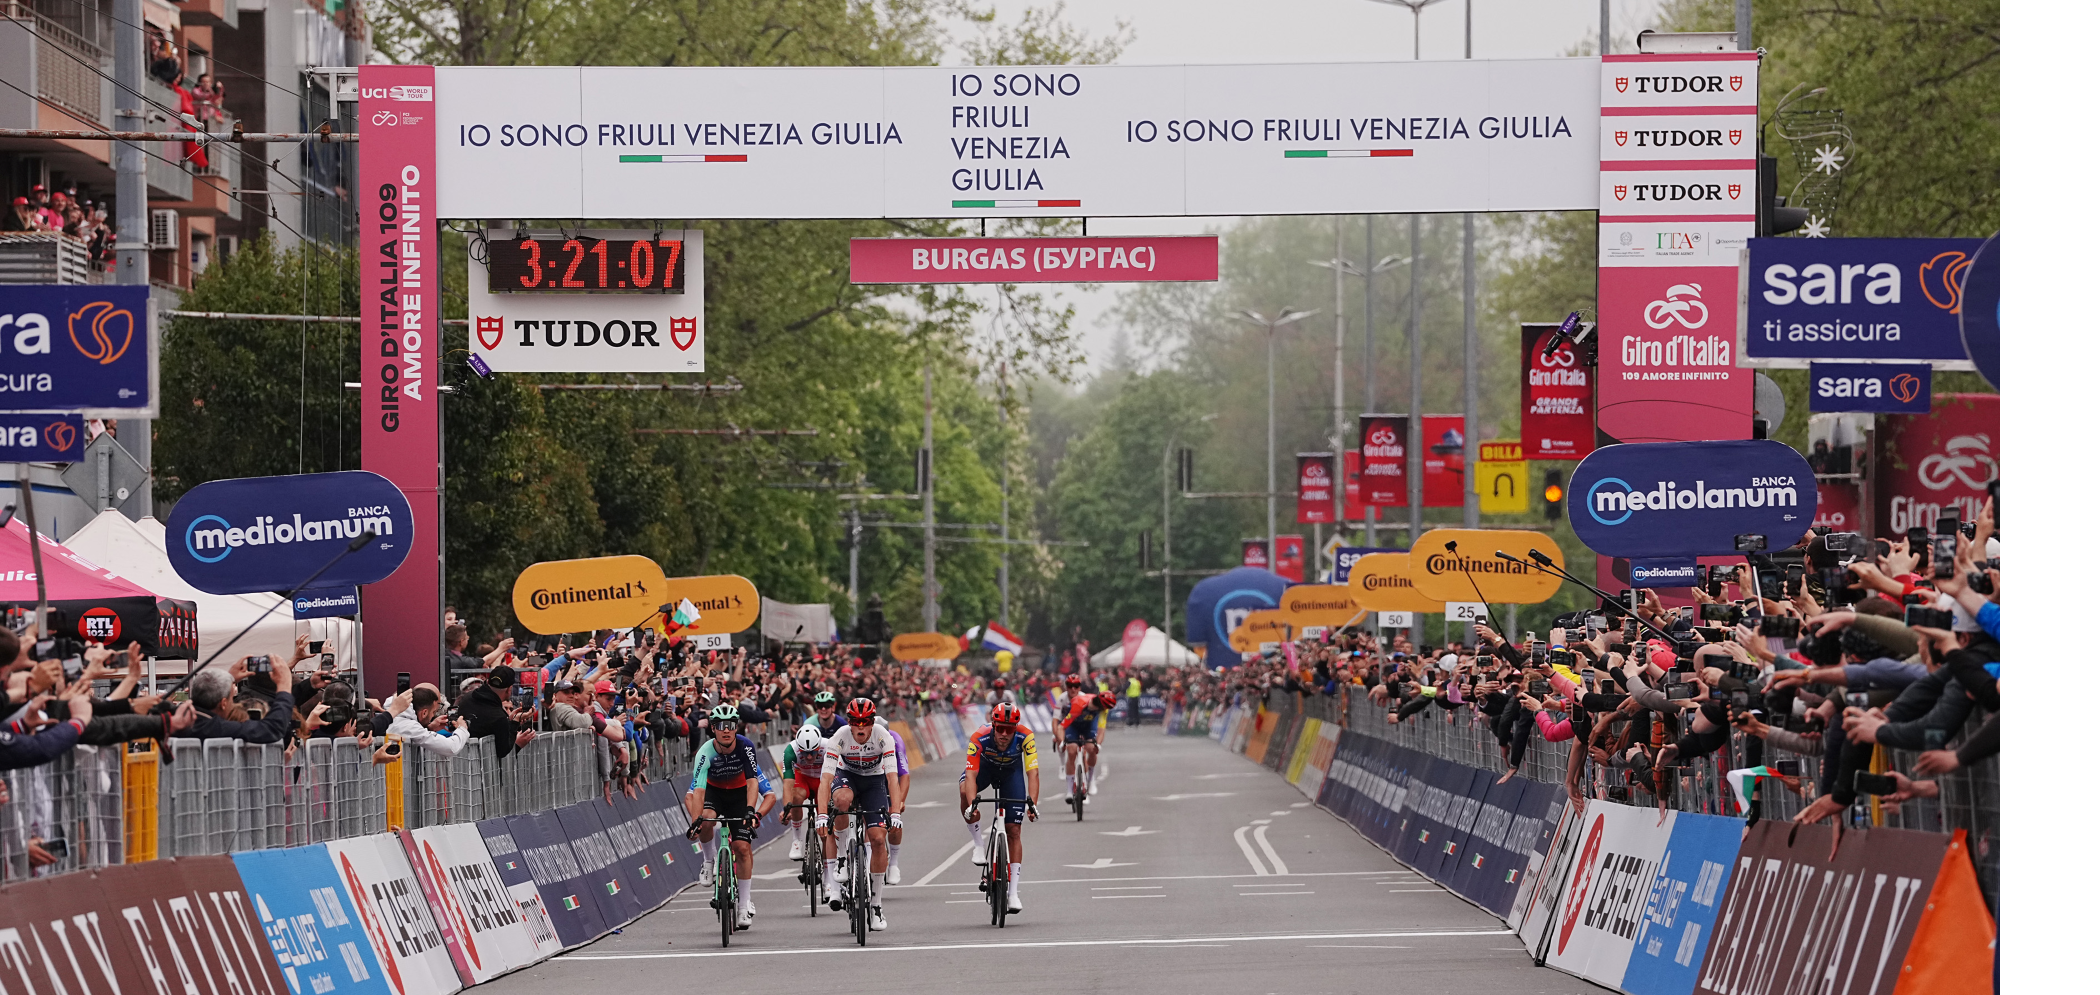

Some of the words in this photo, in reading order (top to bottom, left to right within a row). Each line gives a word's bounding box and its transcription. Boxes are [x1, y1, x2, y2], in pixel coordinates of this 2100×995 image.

[361, 88, 387, 99] UCI
[952, 74, 983, 97] IO
[993, 73, 1081, 97] SONO
[1635, 76, 1724, 93] TUDOR
[952, 105, 1029, 128] FRIULI
[460, 124, 491, 147] IO
[500, 123, 588, 147] SONO
[598, 123, 675, 146] FRIULI
[683, 122, 804, 146] VENEZIA
[811, 121, 903, 146] GIULIA
[1127, 120, 1158, 143] IO
[1166, 119, 1254, 143] SONO
[1264, 118, 1341, 142] FRIULI
[1349, 117, 1470, 141] VENEZIA
[1478, 115, 1573, 140] GIULIA
[1634, 129, 1723, 147] TUDOR
[951, 136, 1071, 160] VENEZIA
[951, 167, 1044, 192] GIULIA
[1633, 183, 1722, 202] TUDOR
[379, 183, 397, 235] 109
[401, 165, 421, 287] INFINITO
[1656, 233, 1694, 250] ITA
[520, 239, 682, 288] 3:21:07
[912, 247, 1027, 270] BURGAS
[1033, 246, 1156, 273] (БУРГАС)
[1762, 262, 1901, 306] sara
[380, 239, 398, 357] D'ITALIA
[514, 319, 660, 348] TUDOR
[1762, 319, 1782, 342] ti
[1788, 318, 1901, 342] assicura
[403, 294, 422, 401] AMORE
[1621, 335, 1663, 367] Giro
[1665, 334, 1730, 367] d'Italia
[1529, 368, 1550, 386] Giro
[1621, 371, 1640, 381] 109
[1641, 371, 1680, 381] AMORE
[1681, 371, 1730, 381] INFINITO
[1817, 377, 1882, 398] sara
[380, 364, 399, 433] GIRO
[1536, 397, 1579, 406] GRANDE
[1530, 406, 1584, 415] PARTENZA
[1481, 446, 1522, 460] BILLA
[1752, 476, 1796, 487] BANCA
[1595, 480, 1798, 512] mediolanum
[347, 505, 391, 518] BANCA
[194, 513, 393, 550] mediolanum
[1425, 553, 1528, 575] Continental
[1634, 567, 1695, 577] mediolanum
[296, 597, 356, 609] mediolanum
[530, 582, 632, 611] Continental
[1290, 599, 1348, 613] Continental
[86, 617, 114, 629] RTL
[1388, 615, 1403, 625] 50
[1457, 606, 1475, 618] 25
[86, 629, 114, 637] 102.5
[706, 636, 722, 647] 50
[744, 745, 758, 773] Adecco
[449, 861, 519, 934] CASTELLI
[1584, 852, 1659, 942] CASTELLI
[371, 876, 441, 958] CASTELLI
